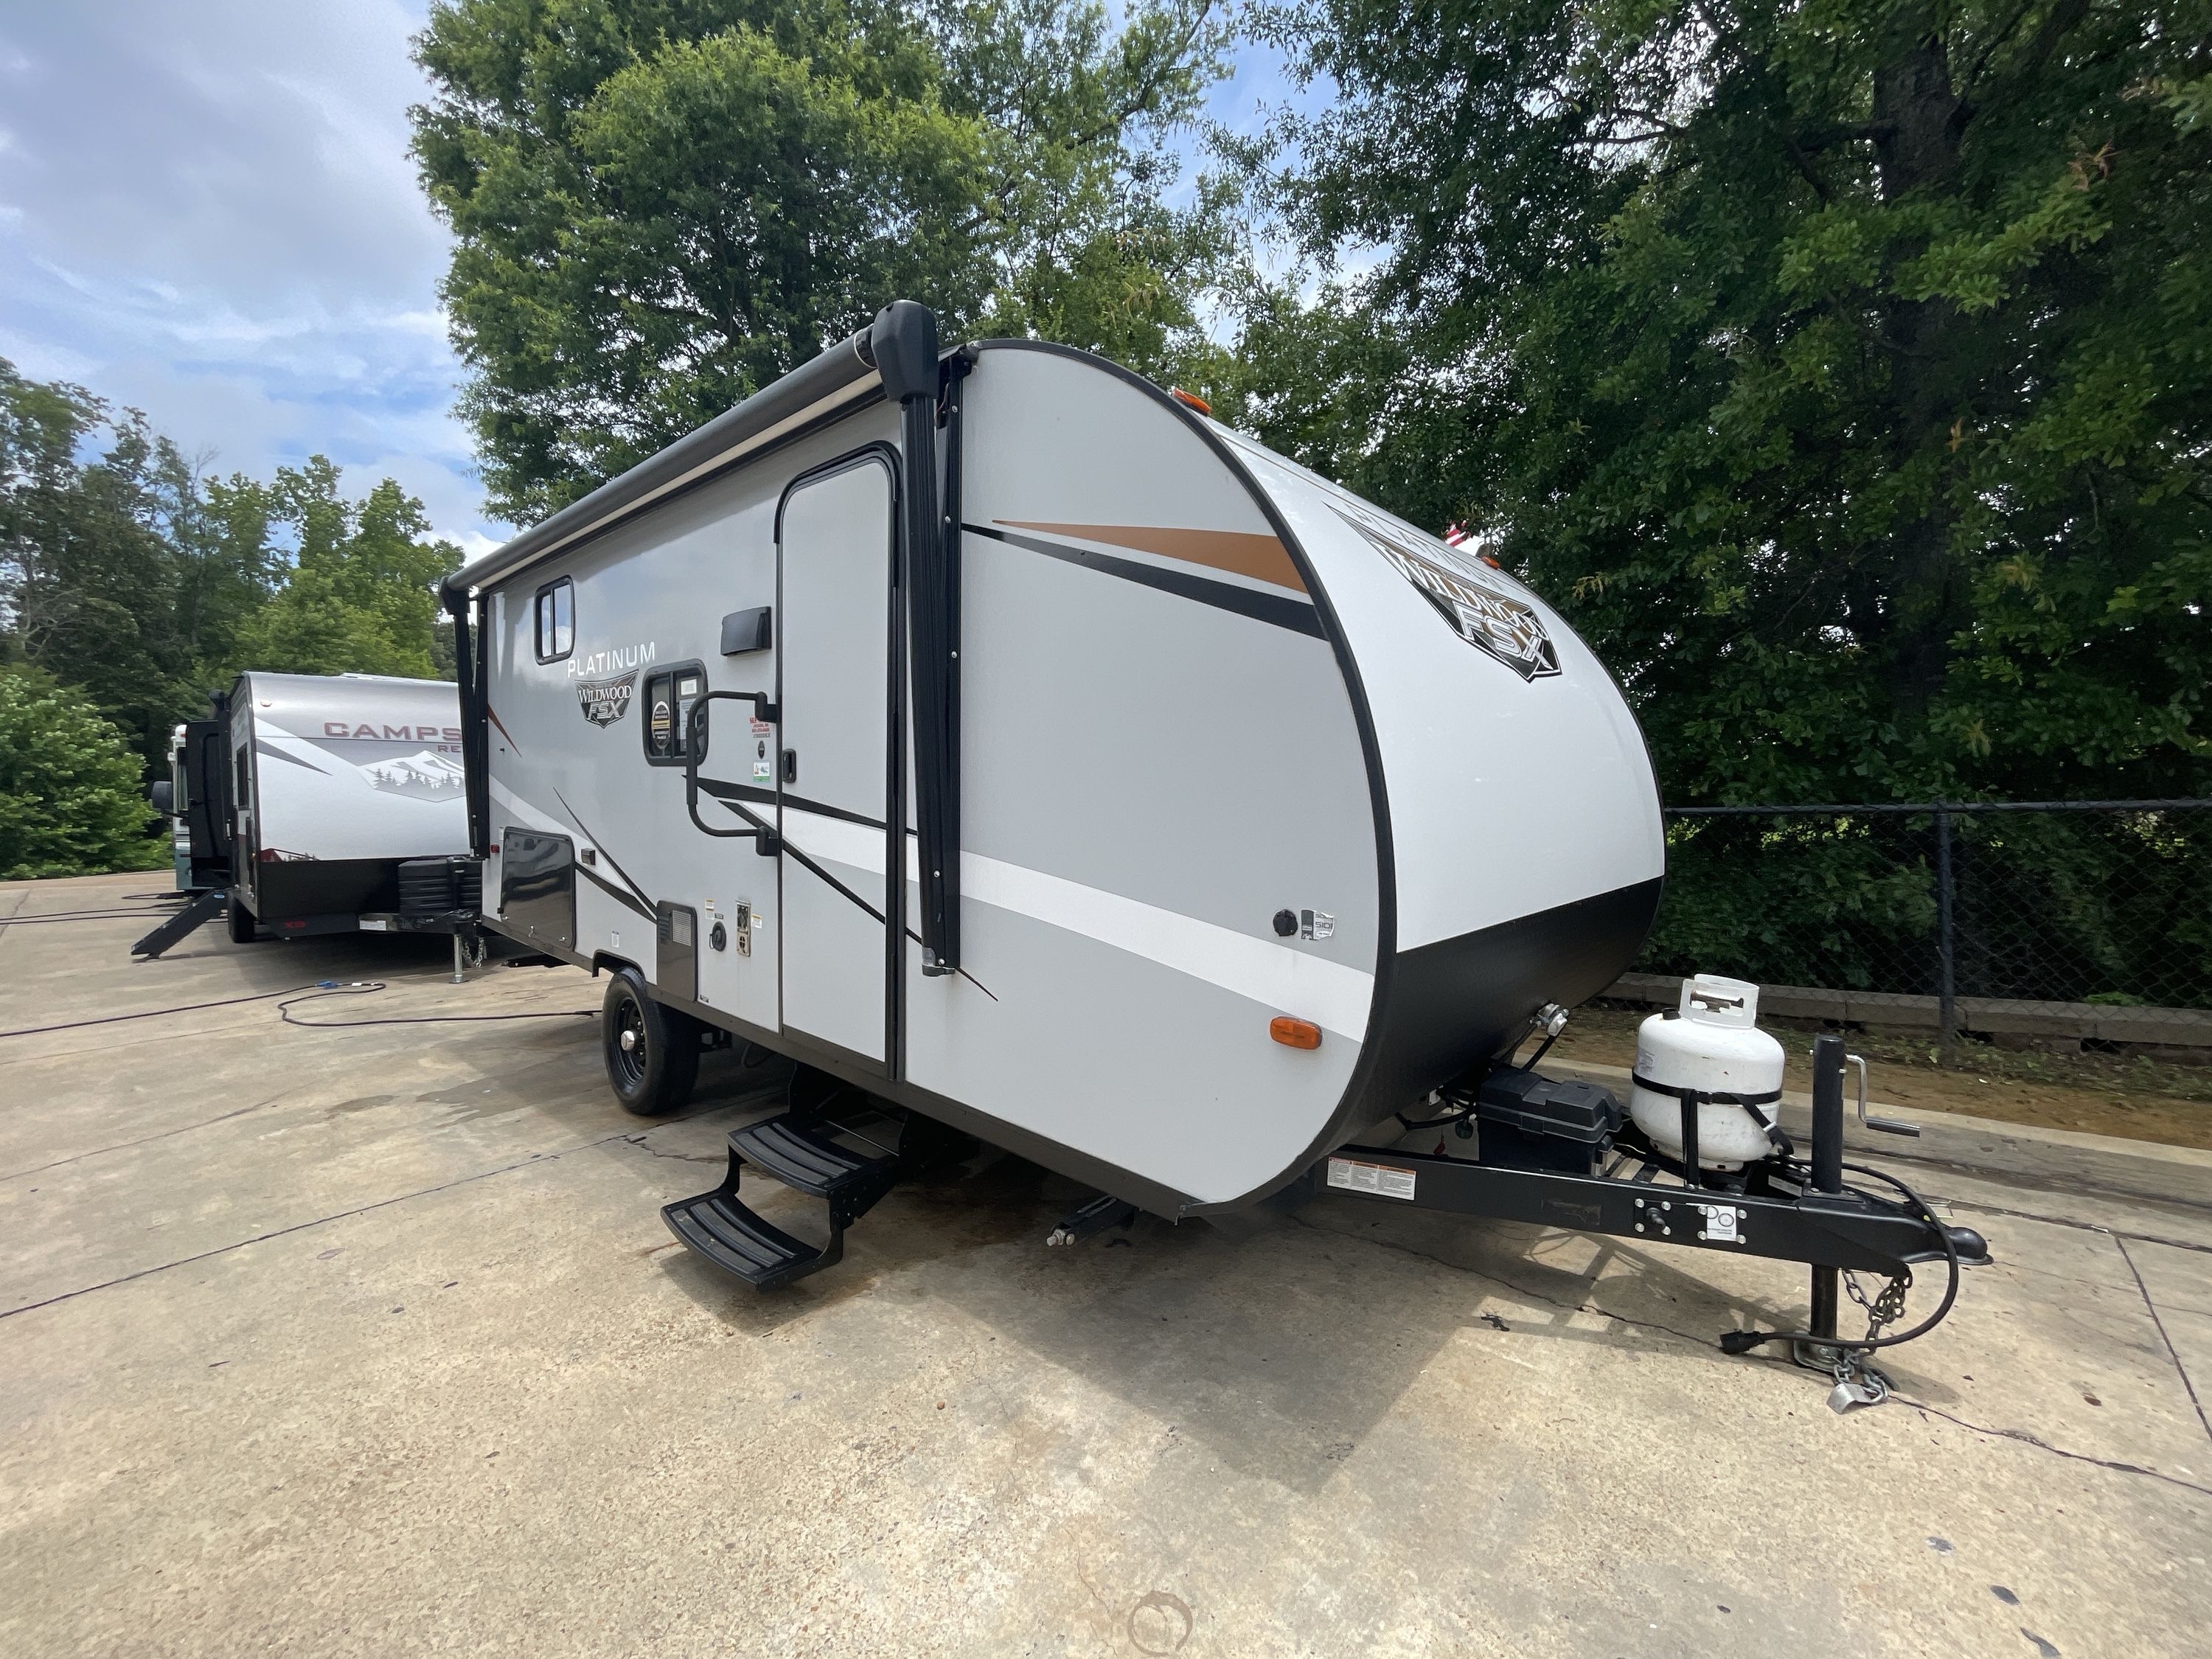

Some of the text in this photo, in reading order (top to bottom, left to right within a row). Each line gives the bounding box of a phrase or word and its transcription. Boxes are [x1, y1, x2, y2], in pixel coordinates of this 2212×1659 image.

[1452, 600, 1554, 670] FSX
[567, 641, 655, 678] PLATINUM
[578, 685, 633, 703] WILDWOOD
[588, 699, 625, 720] FSX
